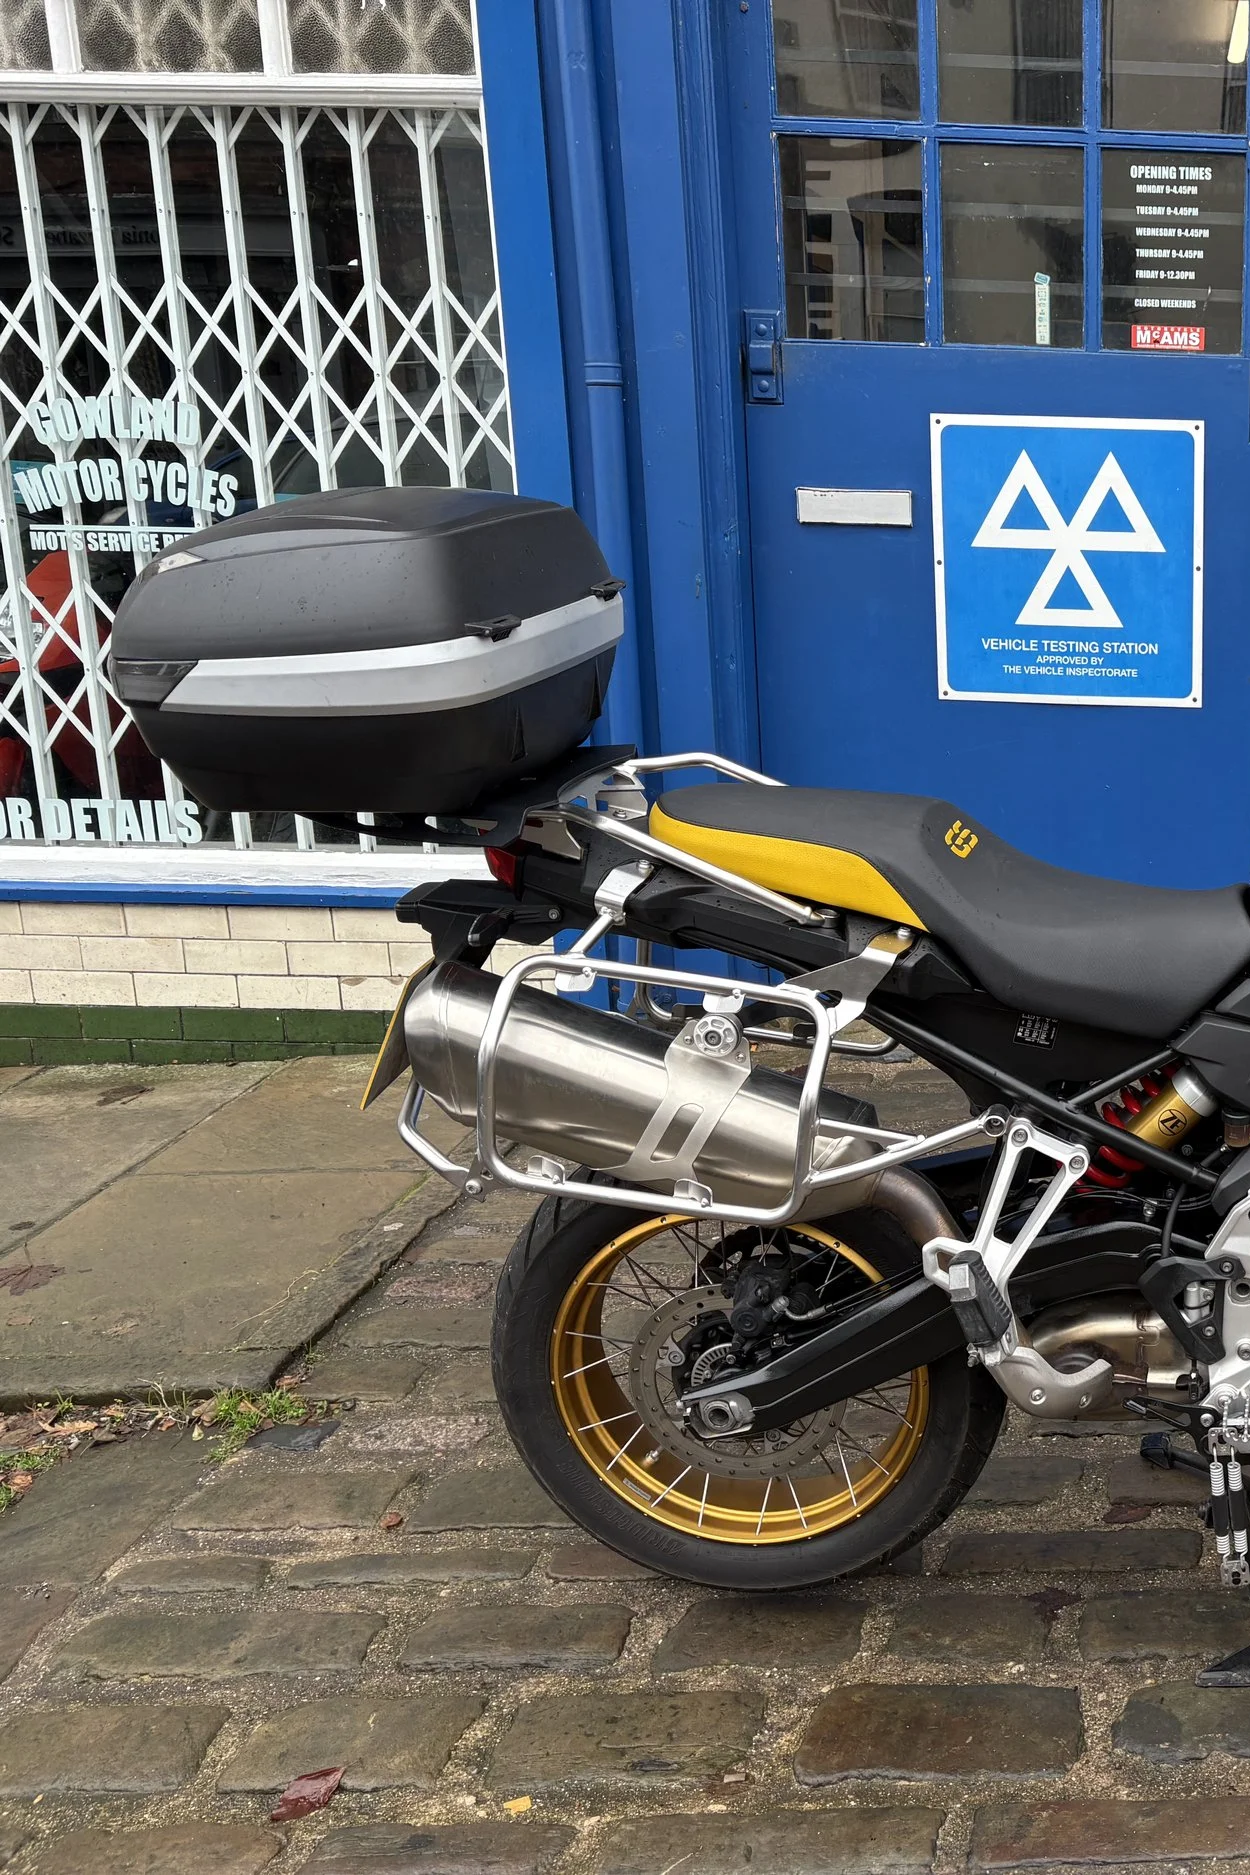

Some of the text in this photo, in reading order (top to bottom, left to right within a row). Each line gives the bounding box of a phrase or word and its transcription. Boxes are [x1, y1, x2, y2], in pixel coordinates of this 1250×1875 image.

[1130, 165, 1213, 181] OPENING TIMES
[1136, 184, 1164, 194] MONDAY
[1136, 206, 1165, 215] TUESDAY
[1135, 227, 1176, 237] WEDNESDAY
[1135, 248, 1171, 258] THURSDAY
[1135, 270, 1159, 279] FRIDAY
[1134, 298, 1197, 309] CLOSED WEEKENDS
[26, 395, 200, 446] GOWLAND
[14, 458, 123, 514] MOTOR
[126, 457, 239, 517] CYCLES
[87, 532, 161, 552] SERVICE
[981, 638, 1159, 655] VEHICLE TESTING STATION
[1036, 656, 1104, 666] APPROVED BY
[1002, 664, 1138, 677] THE VEHICLE INSPECTORATE
[42, 798, 203, 843] DETAILS
